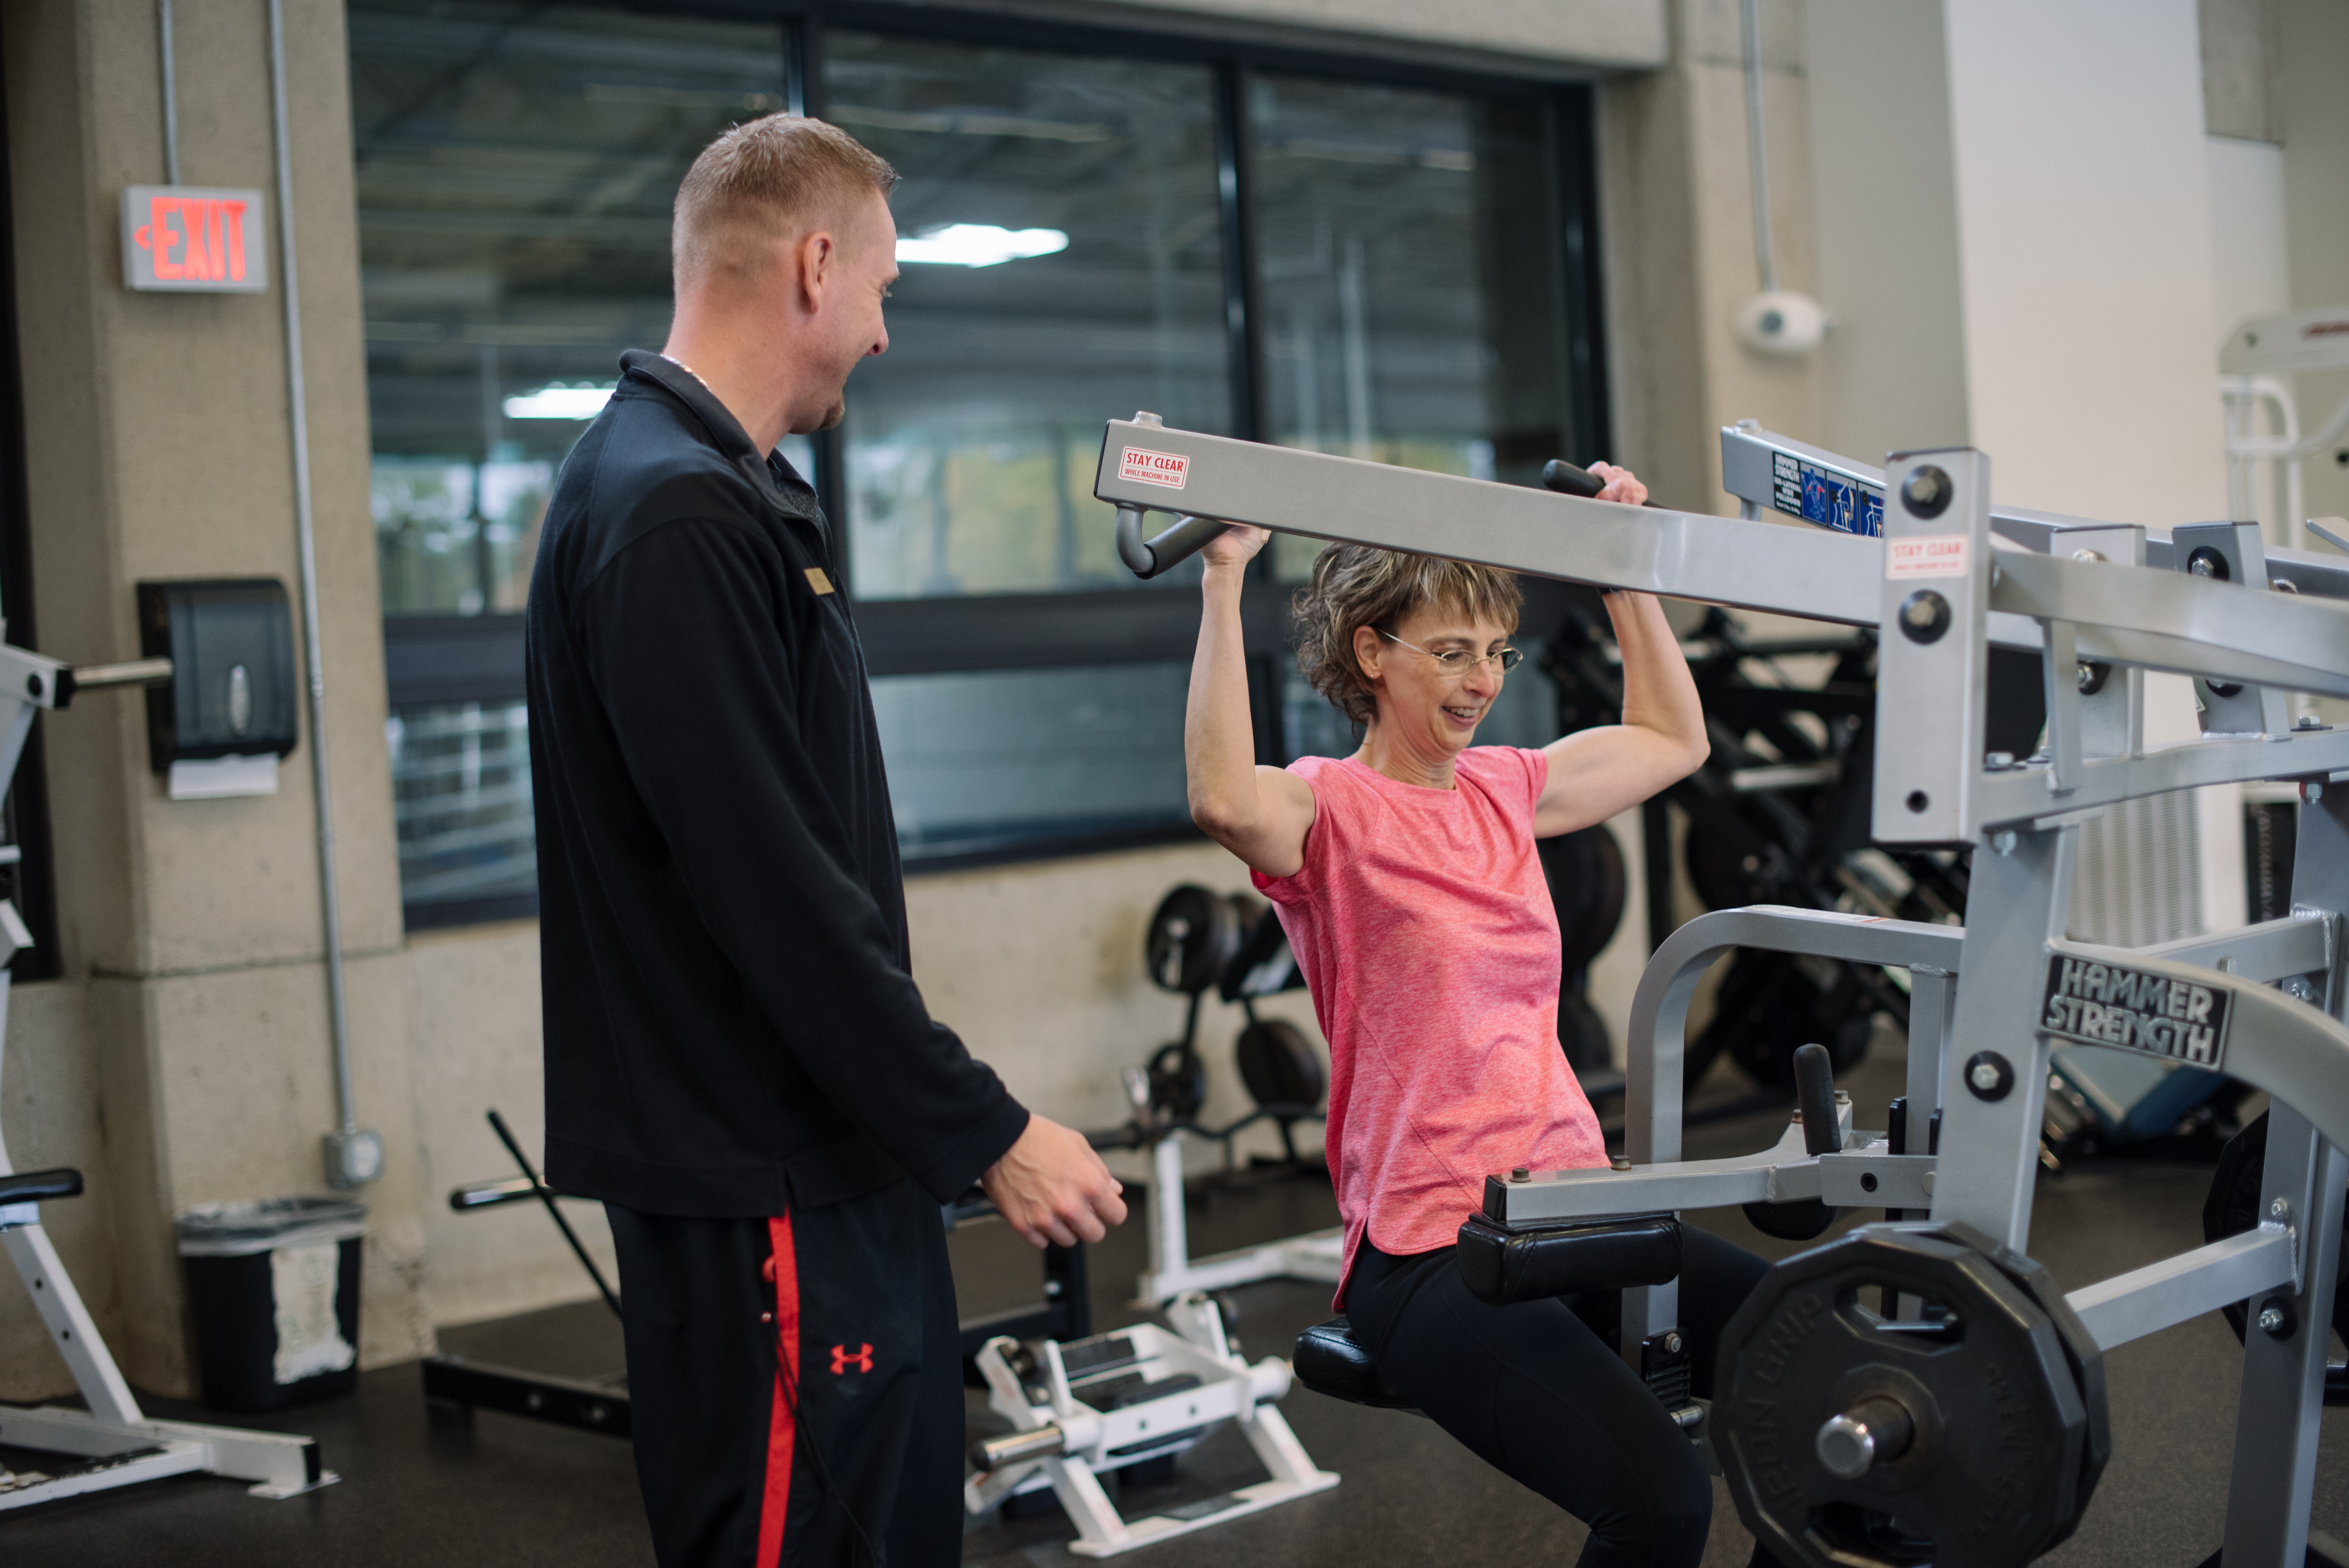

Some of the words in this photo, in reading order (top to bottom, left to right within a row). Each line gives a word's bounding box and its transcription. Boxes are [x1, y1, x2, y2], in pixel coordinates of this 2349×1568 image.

[151, 196, 247, 282] EXIT
[1125, 468, 1140, 476] WHILE
[1141, 470, 1163, 480] MACHINE
[1126, 453, 1152, 466] STAY
[1154, 457, 1183, 472] CLEAR
[1894, 544, 1922, 558] STAY
[1926, 542, 1961, 556] CLEAR
[2059, 959, 2214, 1024] HAMMER
[2046, 995, 2215, 1063] STRENGTH
[1752, 1292, 1823, 1385] GRIP
[1746, 1398, 1803, 1514] IRON
